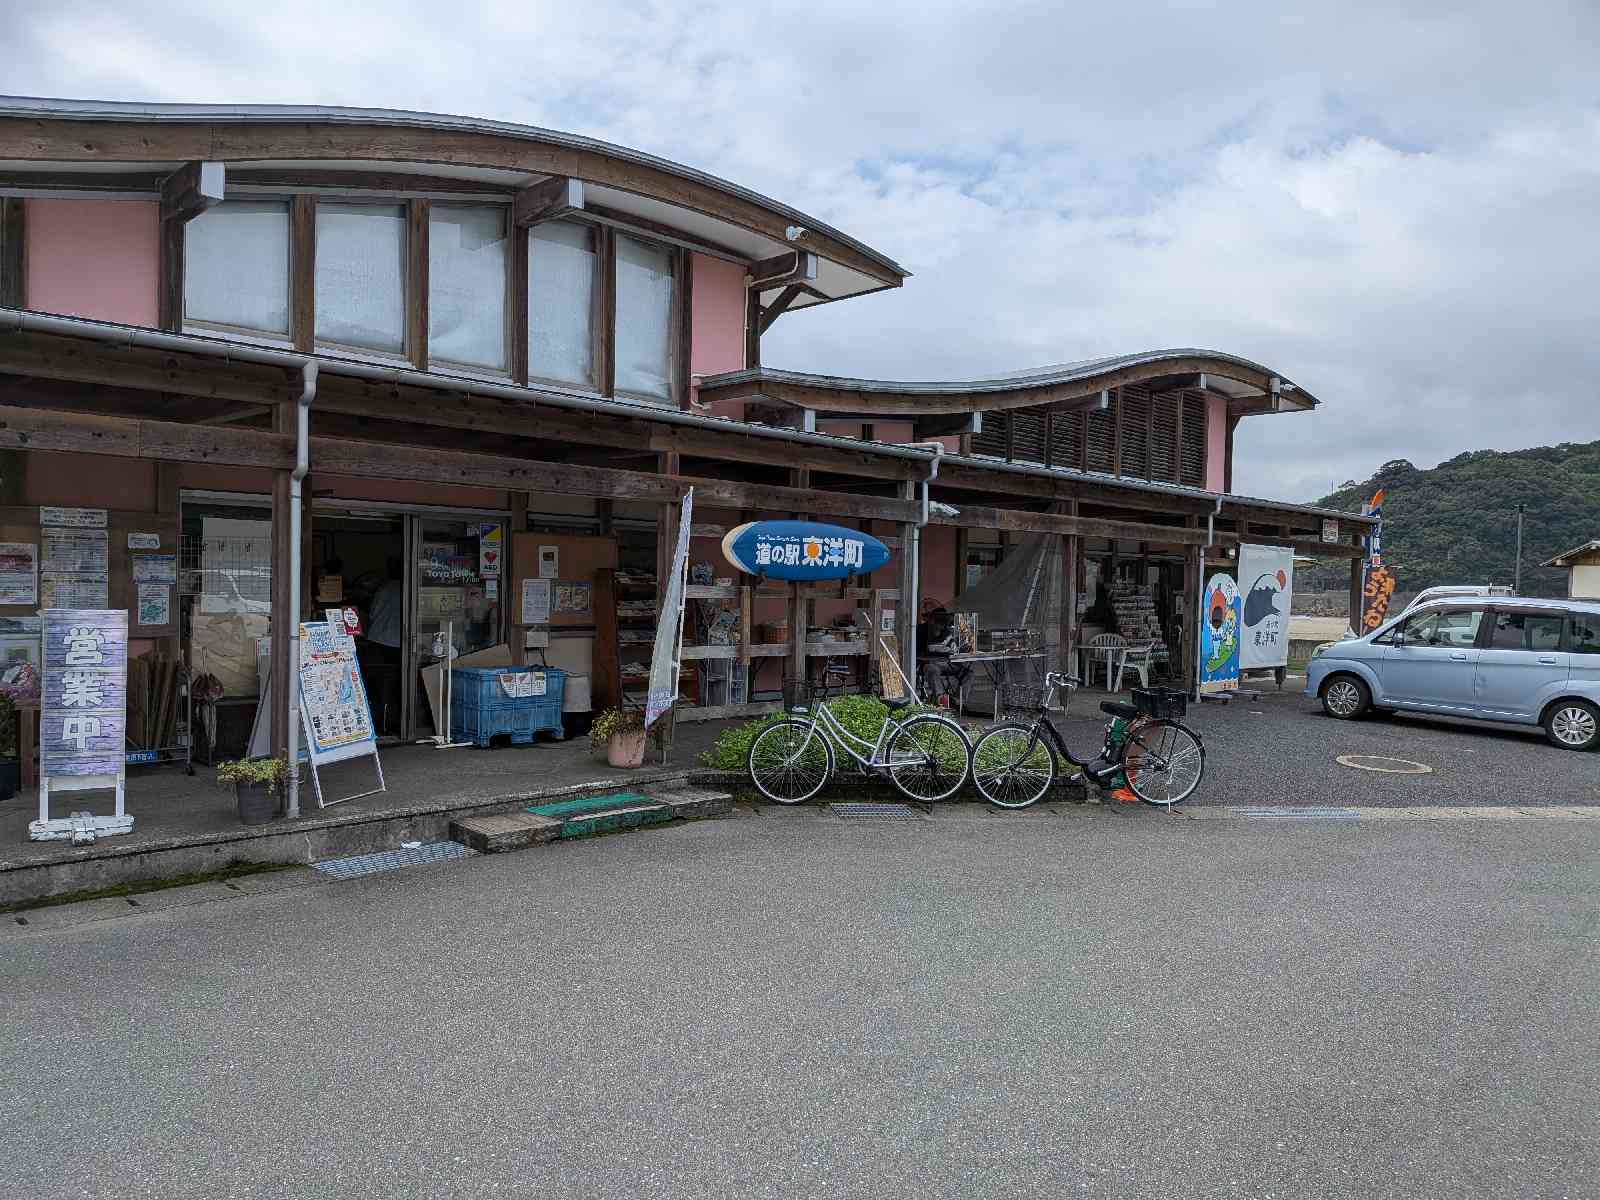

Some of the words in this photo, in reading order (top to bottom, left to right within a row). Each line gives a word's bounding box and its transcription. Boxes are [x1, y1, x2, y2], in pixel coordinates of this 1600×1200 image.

[755, 543, 800, 566] 道の駅
[801, 536, 864, 568] 東洋町
[62, 626, 104, 750] 営業中
